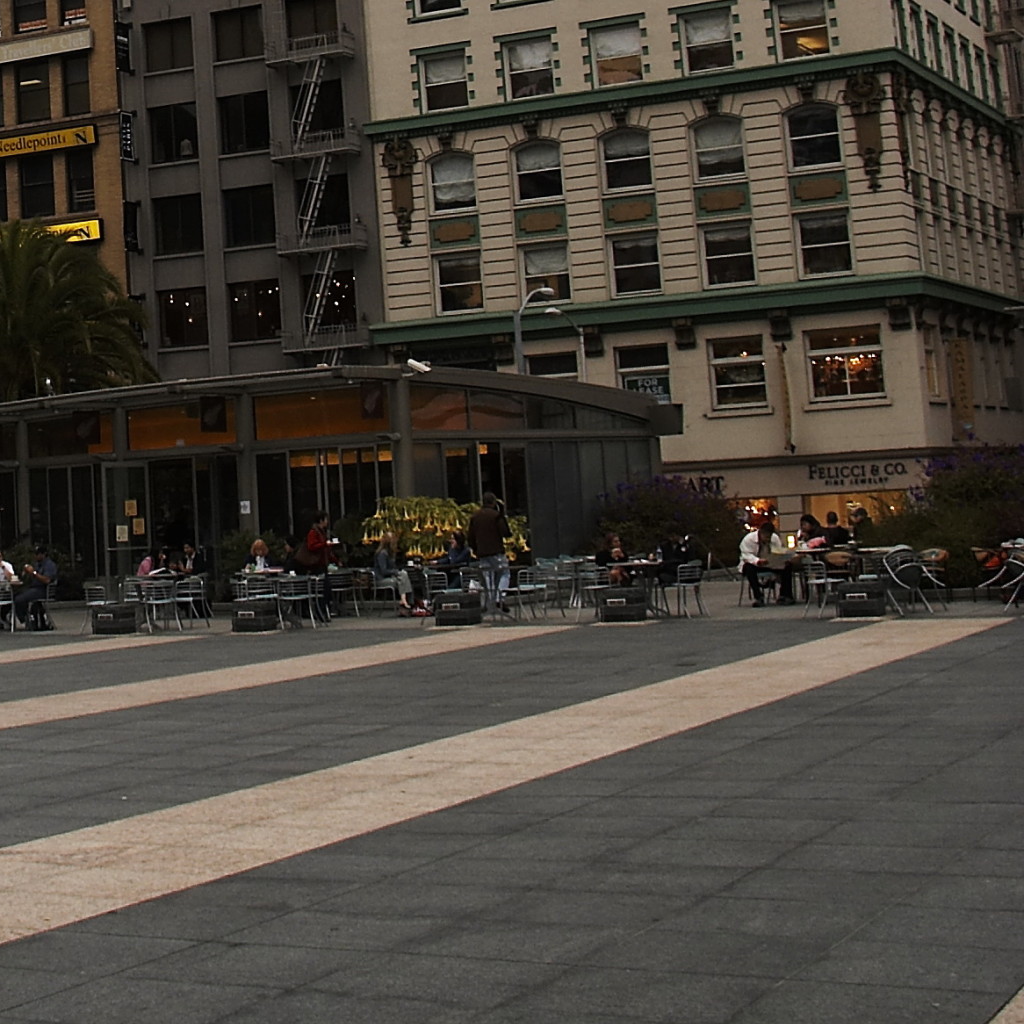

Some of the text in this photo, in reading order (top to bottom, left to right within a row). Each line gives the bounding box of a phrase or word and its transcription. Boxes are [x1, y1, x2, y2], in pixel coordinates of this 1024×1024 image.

[638, 378, 658, 387] FOR
[633, 386, 665, 395] EASE
[808, 462, 909, 480] FELICCI & CO.
